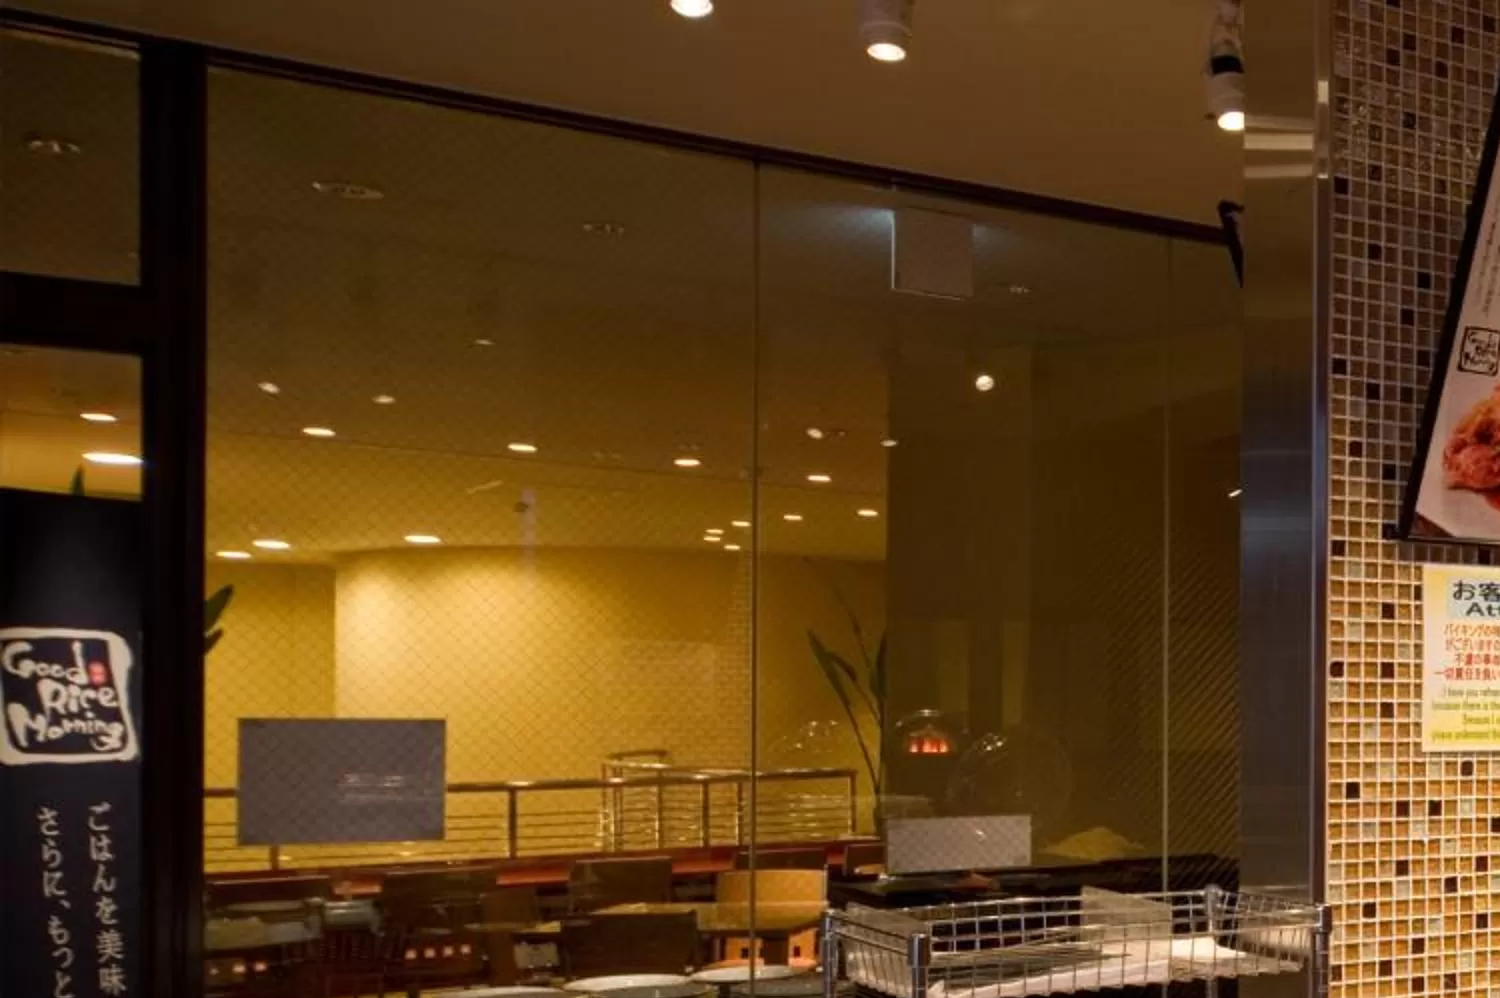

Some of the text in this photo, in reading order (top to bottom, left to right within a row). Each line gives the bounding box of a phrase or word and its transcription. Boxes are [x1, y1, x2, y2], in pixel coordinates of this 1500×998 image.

[3, 641, 89, 685] Good
[37, 678, 119, 715] Rice
[7, 702, 125, 752] Morning
